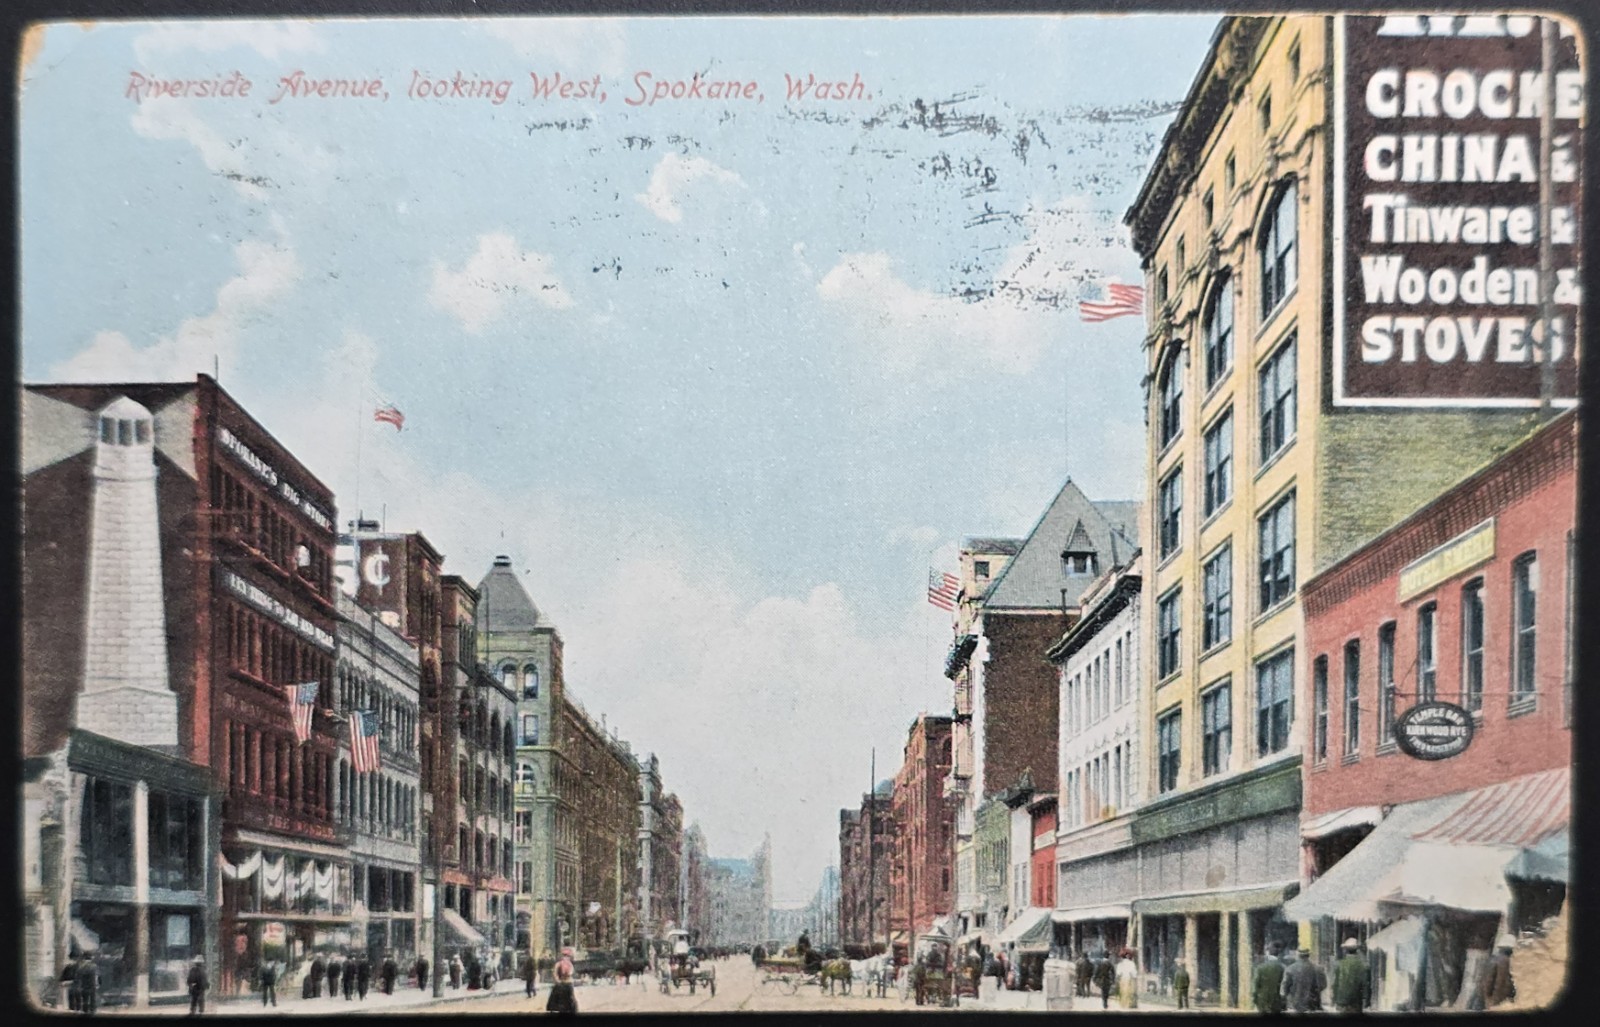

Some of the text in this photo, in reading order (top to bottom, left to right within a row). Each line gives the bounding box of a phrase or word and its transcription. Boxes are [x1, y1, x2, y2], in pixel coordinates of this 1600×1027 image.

[1365, 134, 1538, 183] CHINA
[1363, 194, 1576, 244] Tinware &
[1360, 255, 1582, 305] Wooden &
[1361, 315, 1565, 363] STOVES
[1410, 708, 1445, 724] TEMPLE
